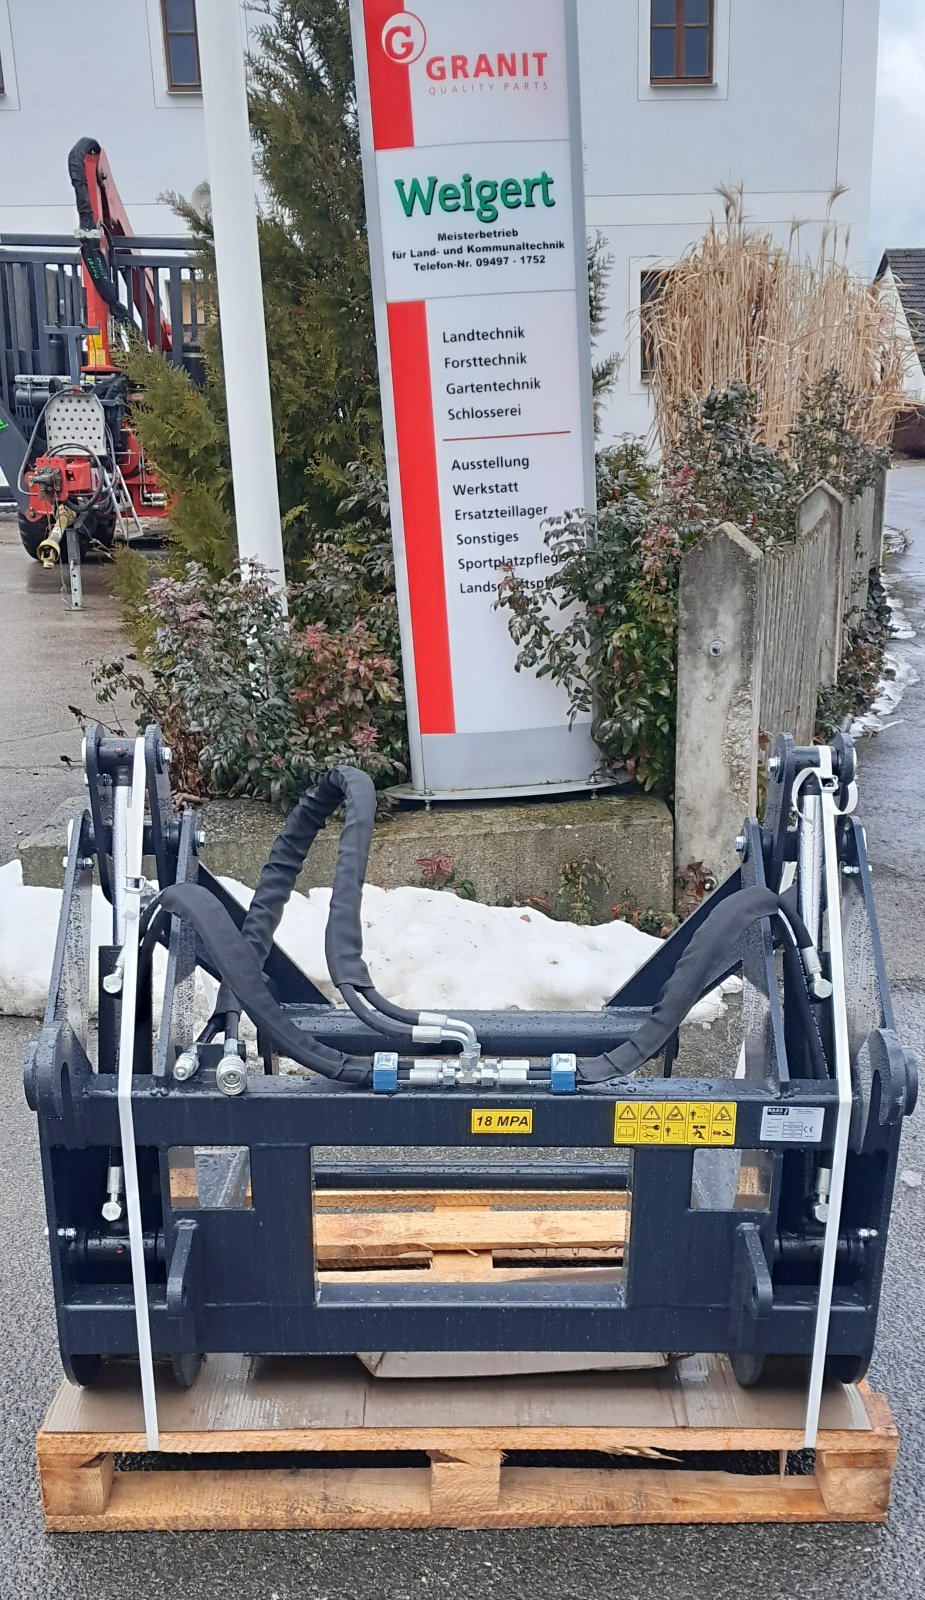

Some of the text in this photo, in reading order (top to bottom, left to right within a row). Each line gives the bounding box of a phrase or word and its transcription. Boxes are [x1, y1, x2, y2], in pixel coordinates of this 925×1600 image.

[385, 25, 414, 60] G
[425, 52, 548, 81] GRANIT
[428, 81, 548, 95] QUALITY PARTS
[394, 171, 556, 223] Weigert
[437, 228, 519, 242] Meisterbetrieb
[391, 240, 565, 260] für Land- und Kommunaltechnik
[413, 259, 473, 272] Telefon-Nr.
[475, 256, 510, 267] 09497
[519, 254, 546, 264] 1752
[442, 325, 526, 344] Landtechnik
[444, 352, 528, 369] Forsttechnik
[446, 378, 542, 395] Gartentechnik
[447, 404, 522, 421] Schlosserei
[451, 456, 530, 471] Ausstellung
[452, 481, 519, 497] Werkstatt
[454, 504, 549, 521] Ersatzteillager
[456, 531, 520, 546] Sonstiges
[476, 1115, 529, 1127] 18 MPA
